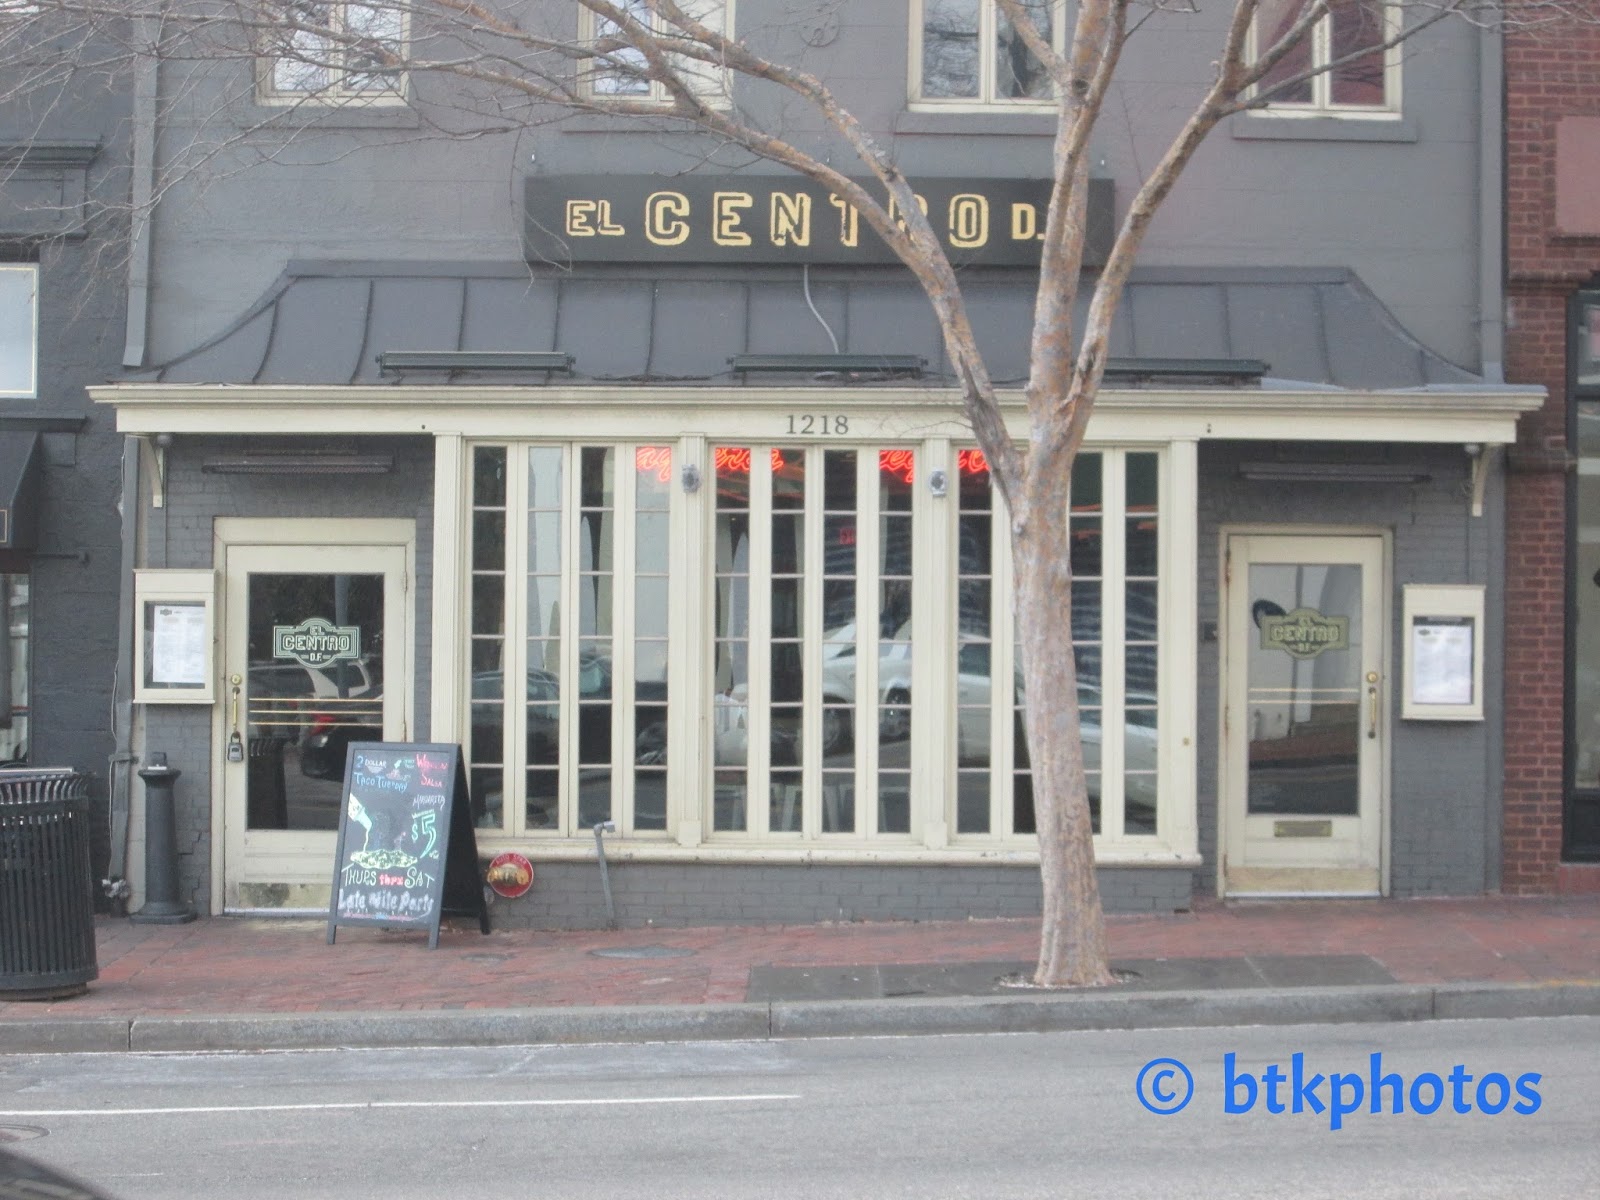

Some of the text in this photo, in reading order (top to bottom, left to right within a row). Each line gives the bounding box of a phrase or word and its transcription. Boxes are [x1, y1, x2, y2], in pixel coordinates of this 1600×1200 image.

[565, 200, 625, 236] EL
[786, 415, 849, 434] 1218
[309, 625, 325, 636] EL
[1270, 624, 1340, 641] CENTRO
[282, 634, 350, 652] CENTRO
[365, 759, 387, 769] DOLLAR
[353, 771, 376, 787] TACO
[341, 862, 377, 887] THURS
[404, 866, 436, 889] SAT
[338, 888, 366, 910] Late
